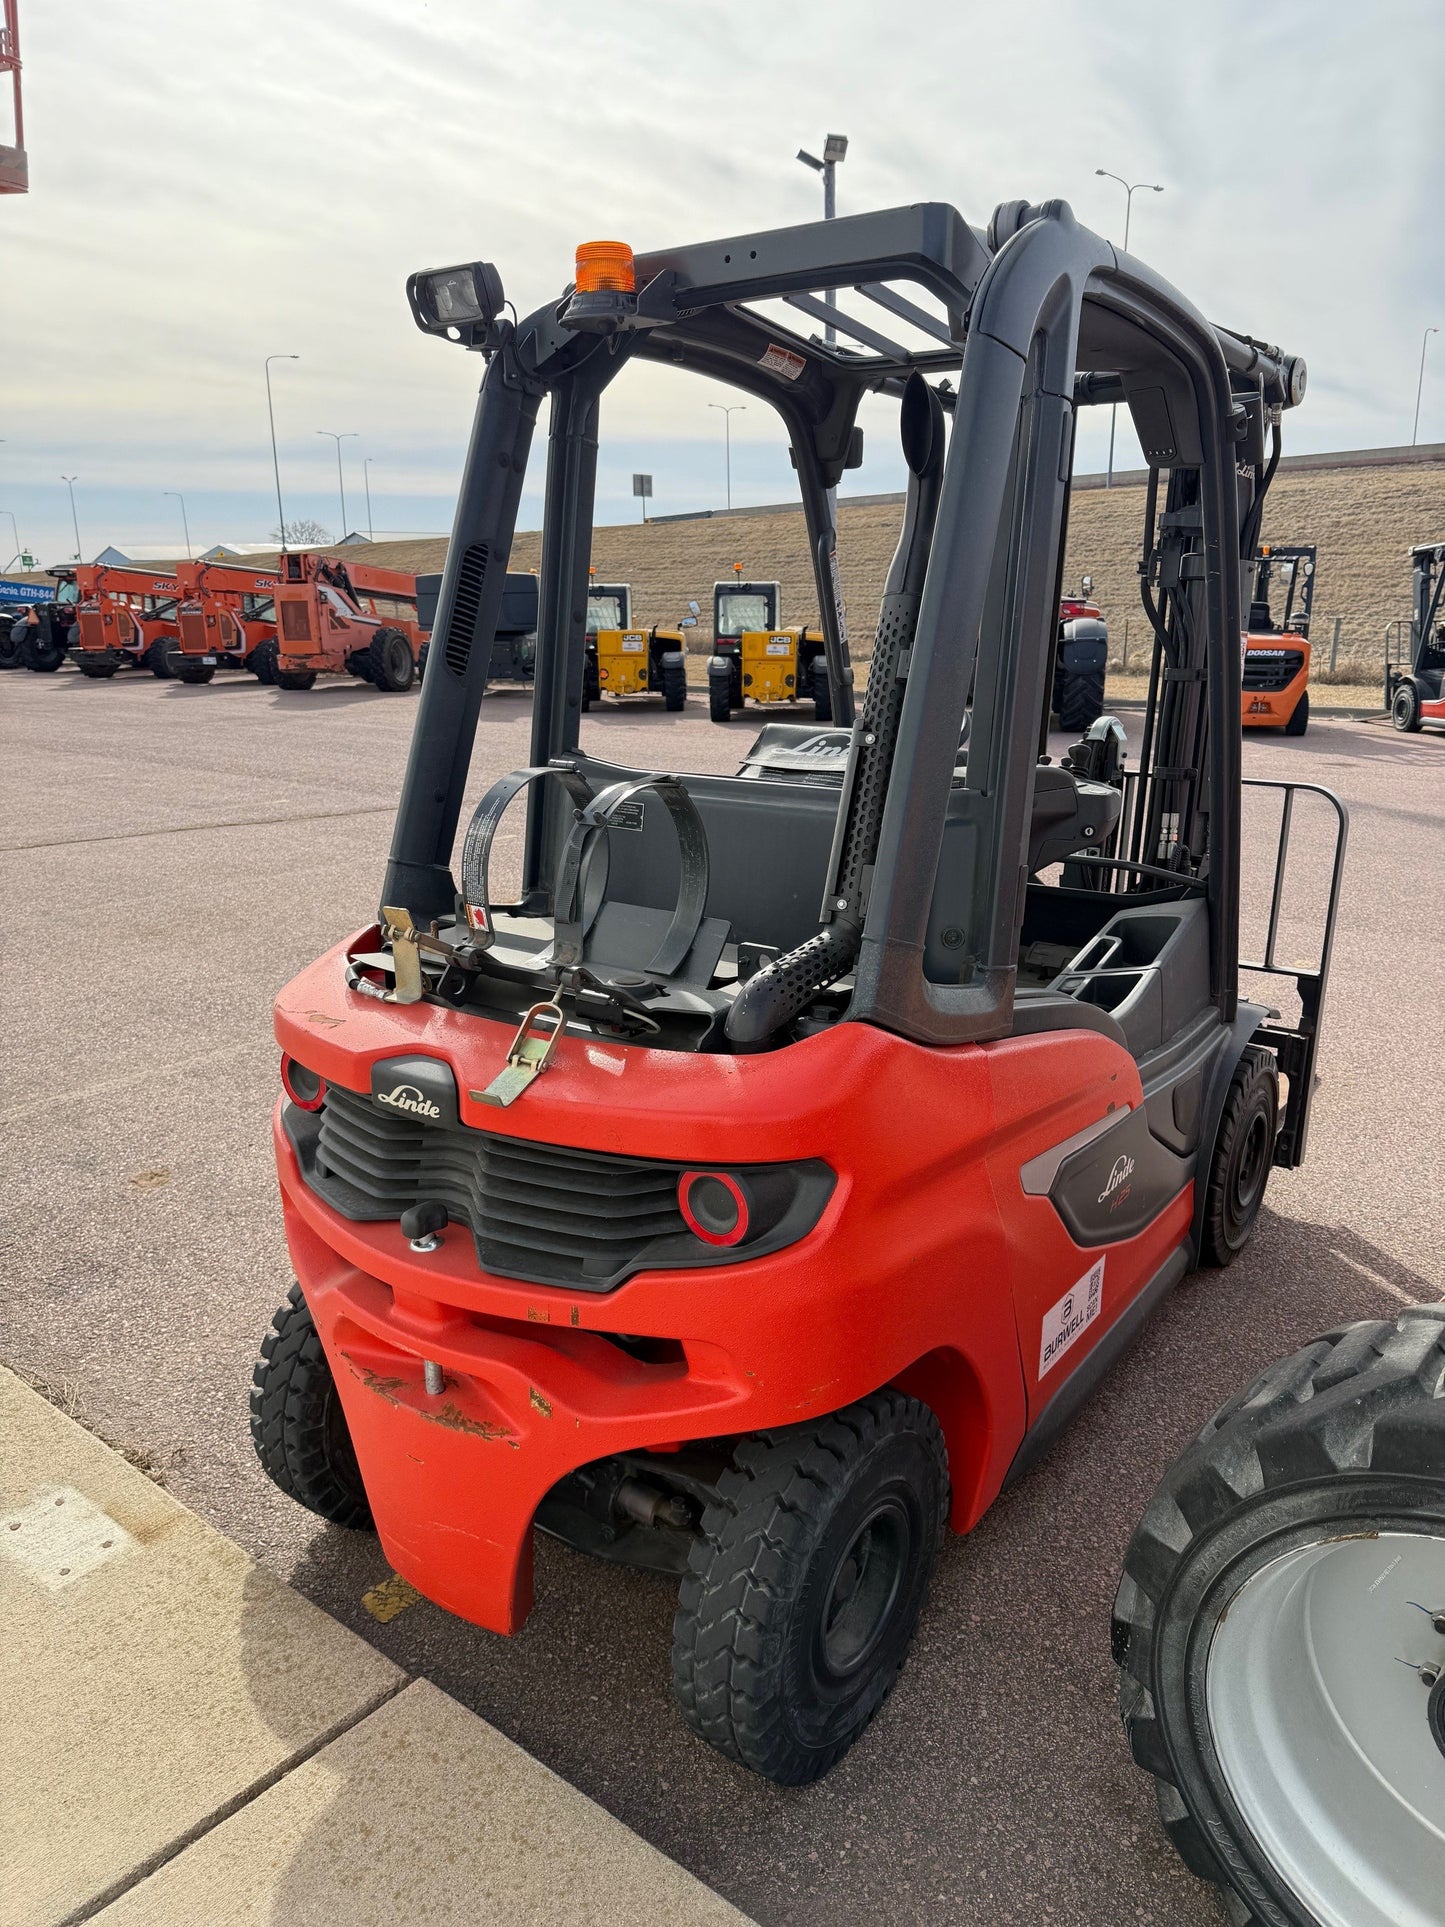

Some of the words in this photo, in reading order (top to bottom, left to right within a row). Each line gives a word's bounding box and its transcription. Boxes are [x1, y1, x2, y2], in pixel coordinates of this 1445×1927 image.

[20, 587, 55, 599] GTH-844
[1246, 649, 1286, 657] DOOSAN
[377, 1084, 440, 1119] Linde
[1098, 1154, 1135, 1203] Linde
[1043, 1310, 1085, 1363] BURWELL
